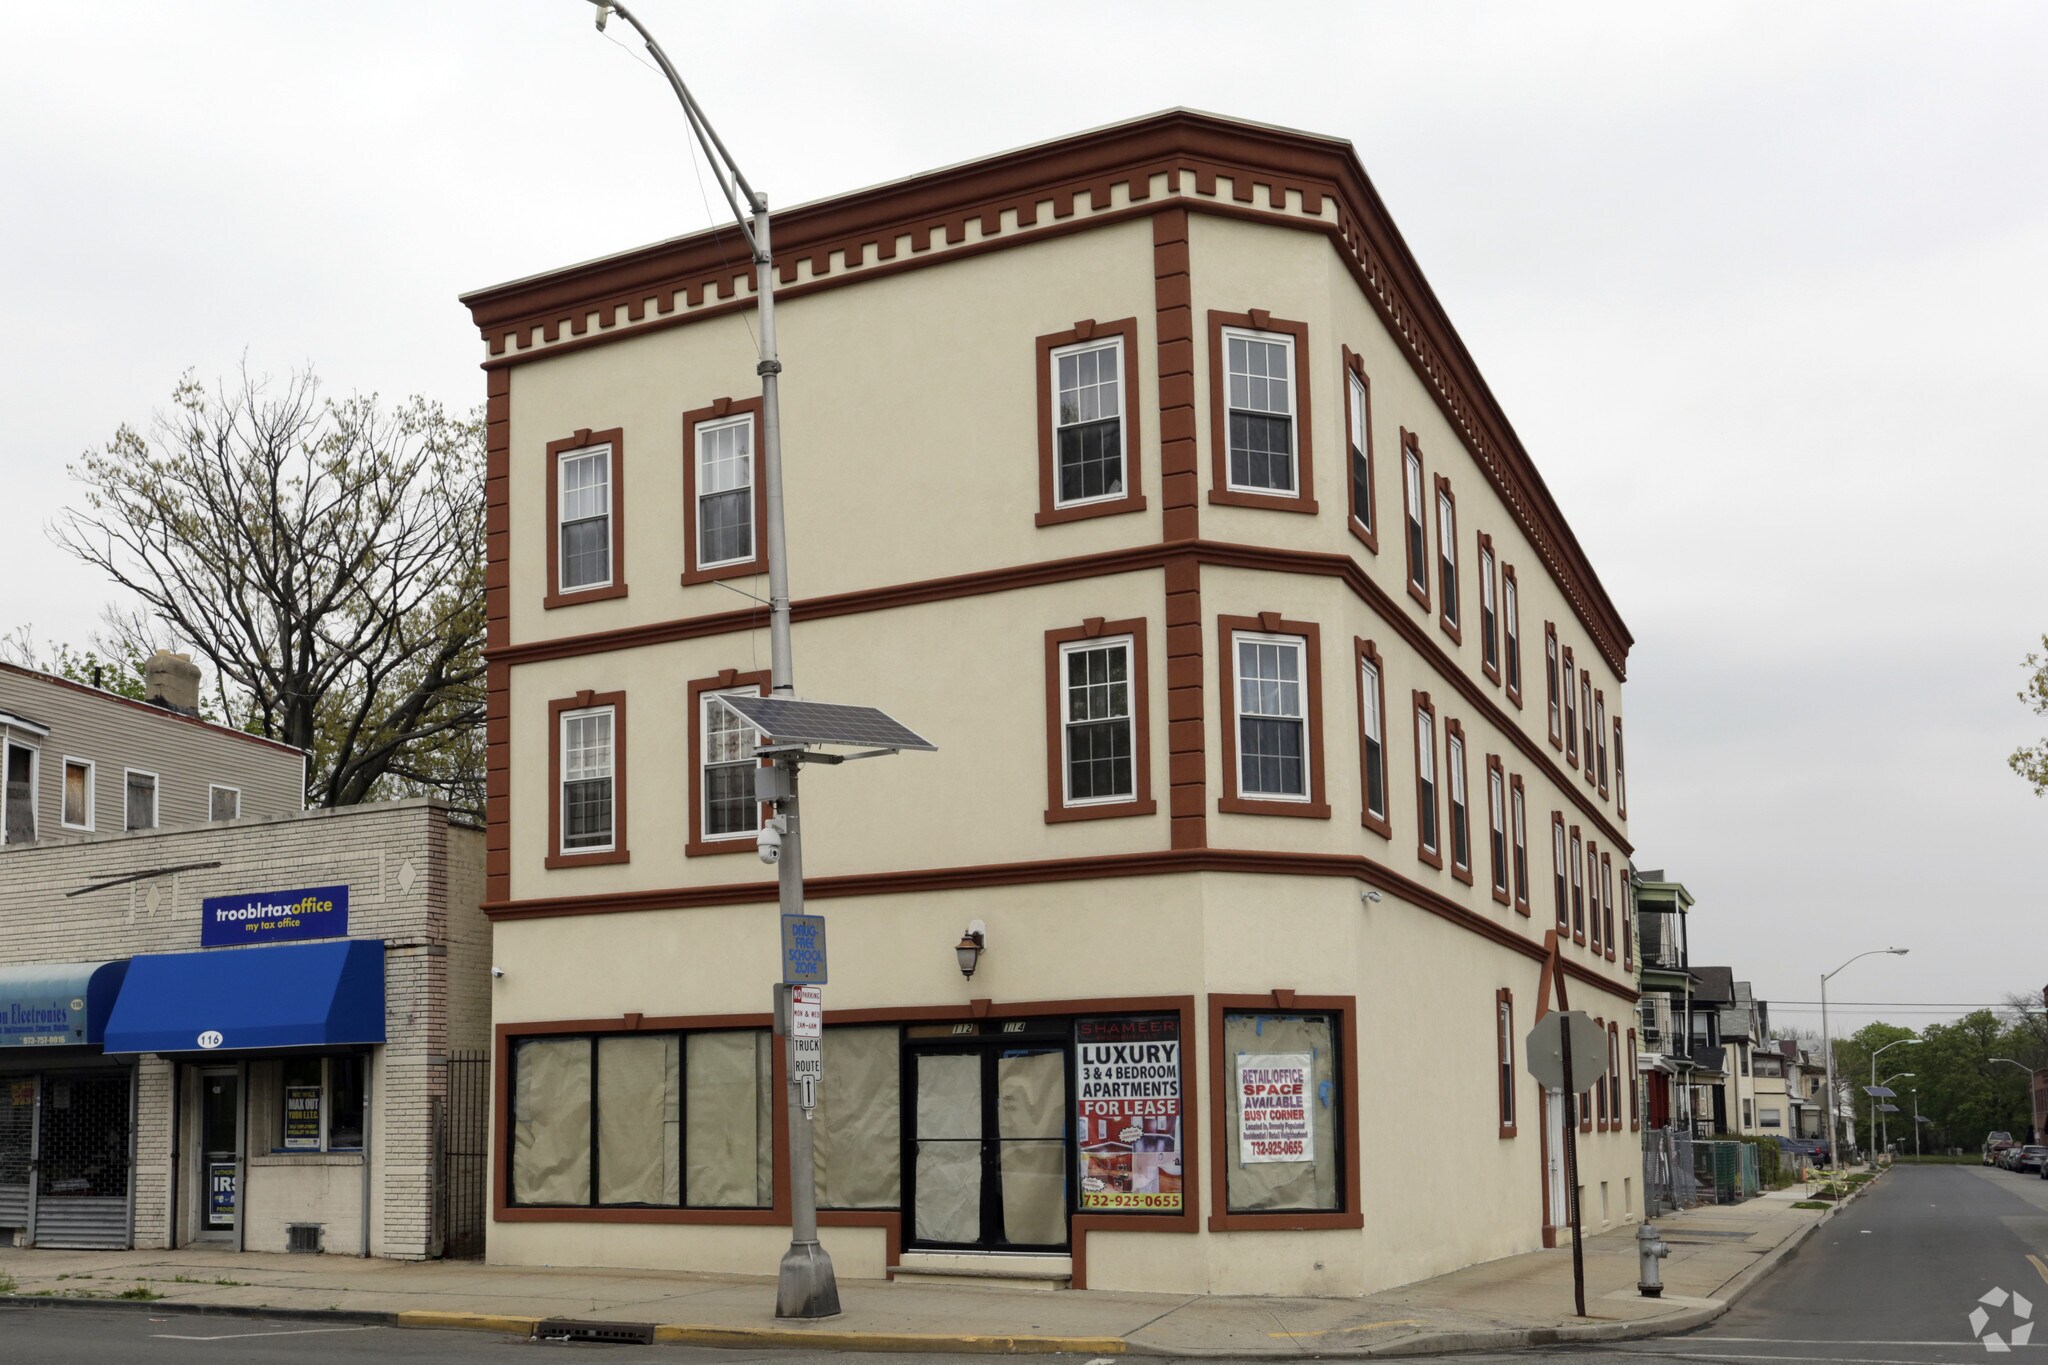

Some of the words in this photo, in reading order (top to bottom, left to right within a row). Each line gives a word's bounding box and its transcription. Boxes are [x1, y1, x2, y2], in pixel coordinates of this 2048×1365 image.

[246, 922, 258, 932] my
[261, 921, 275, 929] tax
[278, 918, 300, 928] office
[796, 937, 815, 949] FREE
[789, 949, 823, 962] SCHOOL
[795, 962, 818, 974] ZONE
[794, 989, 802, 999] NO
[802, 991, 820, 1000] PARKING
[12, 1001, 67, 1024] Electronics
[954, 1024, 973, 1033] 112
[1004, 1022, 1025, 1032] 114
[1080, 1021, 1175, 1034] SHAMEER
[202, 1035, 219, 1044] 116
[795, 1040, 819, 1051] TRUCK
[1083, 1044, 1176, 1064] LUXURY
[796, 1061, 819, 1072] ROUTE
[1084, 1067, 1090, 1080] 3
[1094, 1067, 1102, 1080] &
[1105, 1067, 1112, 1079] 4
[1116, 1065, 1176, 1079] BEDROOM
[1242, 1069, 1304, 1084] RETAIL/OFFICE
[1083, 1080, 1177, 1097] APARTMENTS
[1244, 1084, 1303, 1096] SPACE
[288, 1098, 304, 1110] MAX
[305, 1098, 319, 1110] OUT
[1085, 1101, 1119, 1115] FOR
[1124, 1100, 1176, 1115] LEASE
[1245, 1096, 1303, 1109] AVAILABLE
[1244, 1110, 1267, 1121] BUSY
[1270, 1110, 1304, 1120] CORNER
[1269, 1122, 1284, 1131] Densely
[1285, 1122, 1305, 1130] Populated
[1281, 1131, 1308, 1140] Neighborhood
[1251, 1141, 1303, 1156] 732-925-0655
[1084, 1194, 1179, 1207] 732-925-0655
